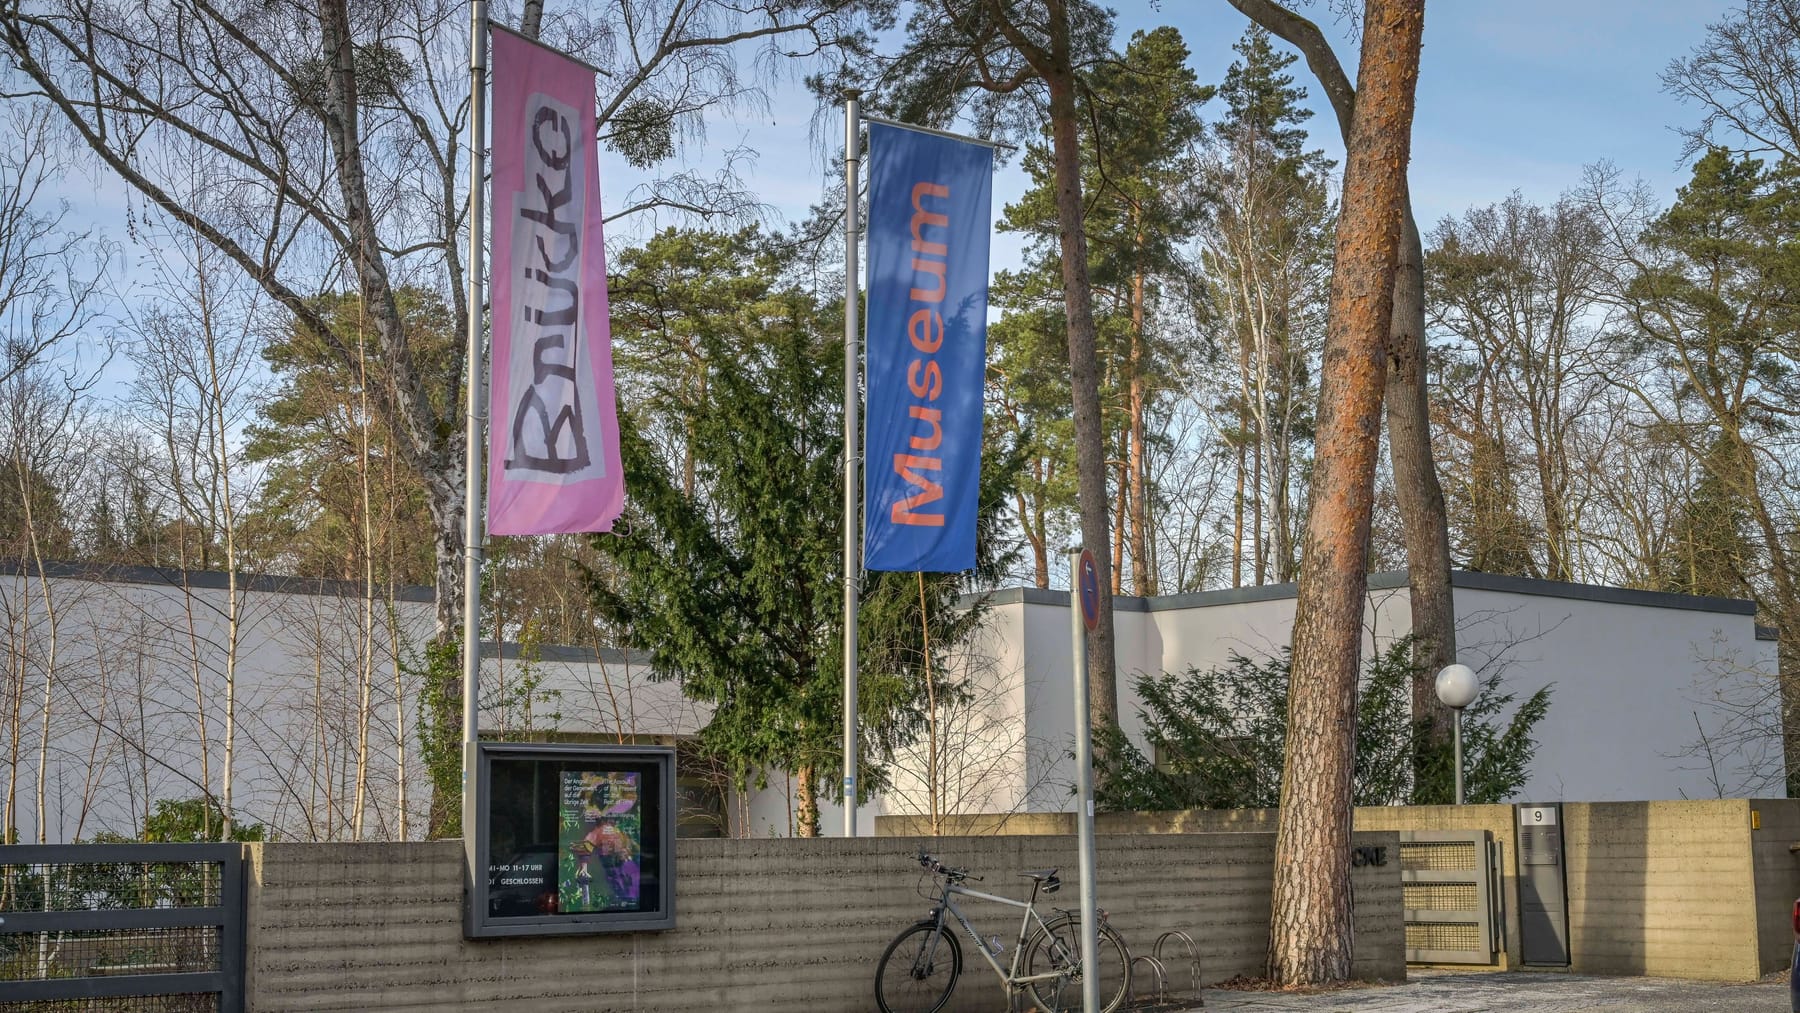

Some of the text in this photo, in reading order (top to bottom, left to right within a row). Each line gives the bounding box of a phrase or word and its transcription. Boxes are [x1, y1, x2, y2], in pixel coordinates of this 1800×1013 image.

[504, 105, 590, 473] Brücke
[890, 181, 949, 527] Museum
[1535, 811, 1542, 822] 9
